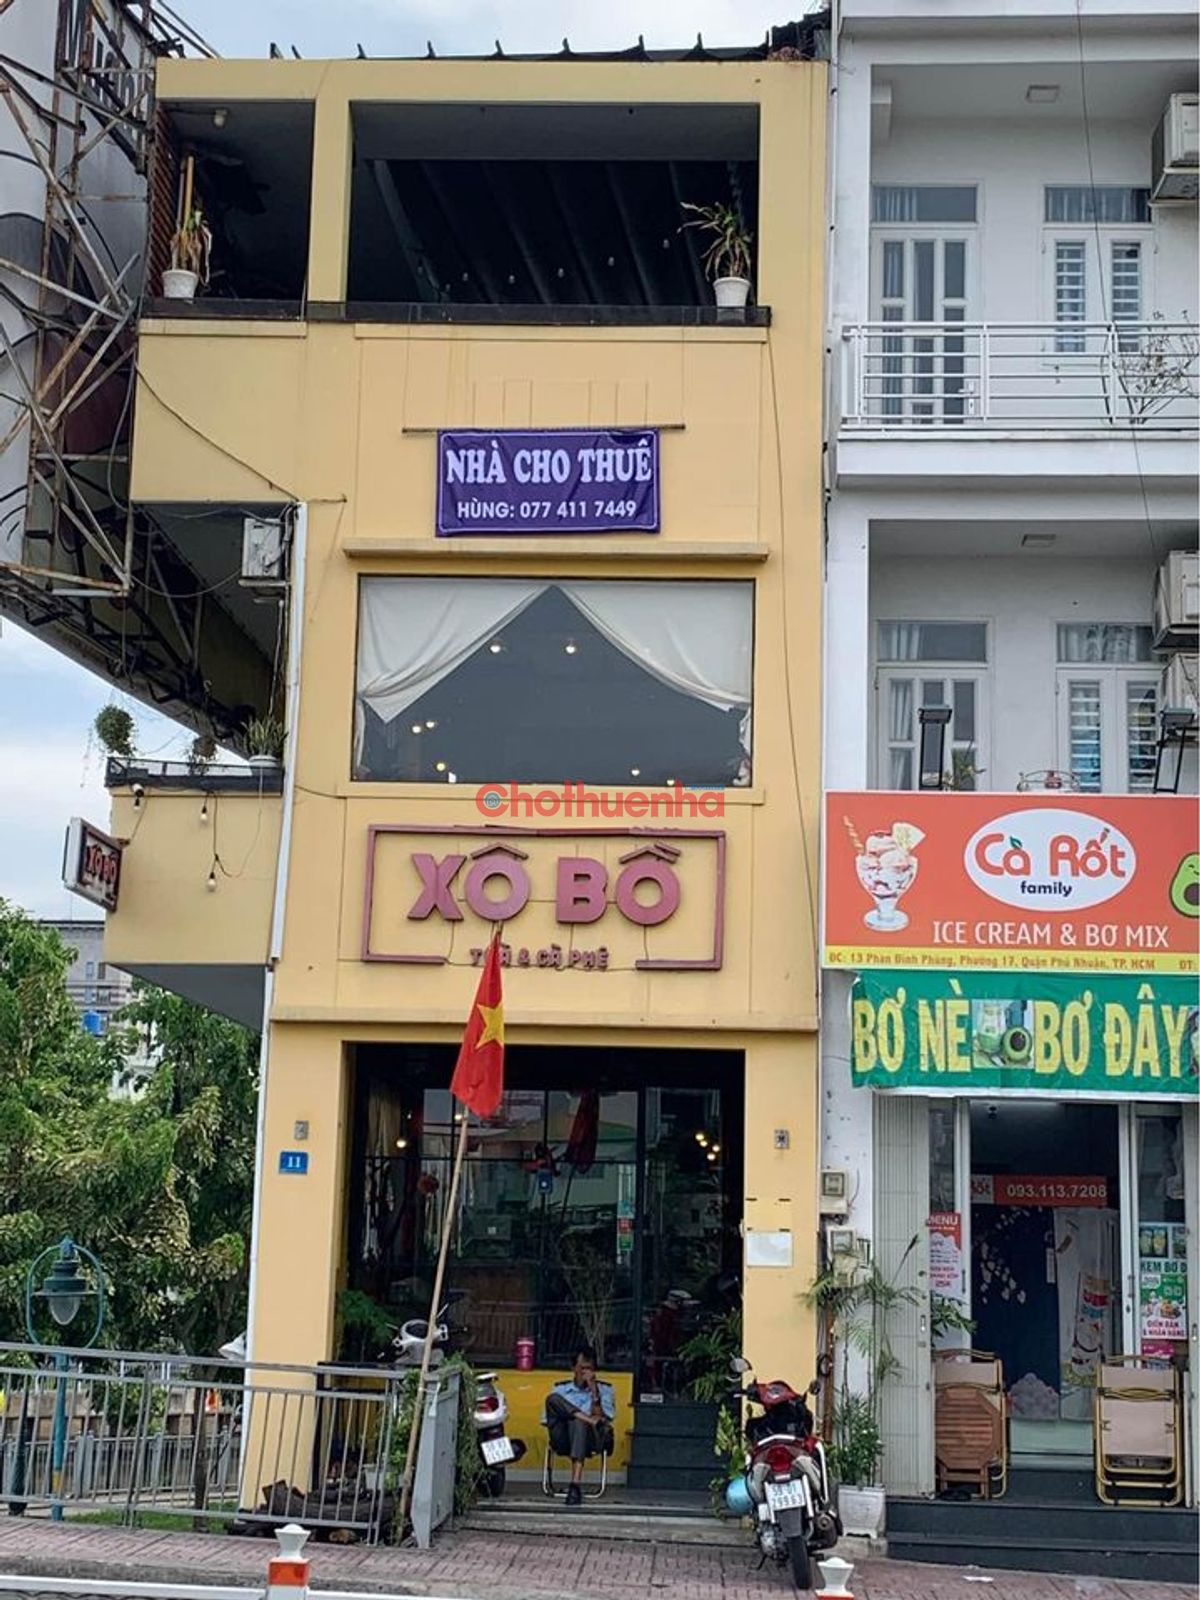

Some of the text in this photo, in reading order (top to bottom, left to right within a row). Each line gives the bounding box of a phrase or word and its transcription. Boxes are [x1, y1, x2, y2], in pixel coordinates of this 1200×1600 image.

[446, 438, 652, 484] NHÀ CHO THUÊ
[457, 497, 636, 518] HÙNG: 077 411 7449
[974, 827, 1126, 878] Cà Rốt
[407, 842, 531, 922] XÔ
[1020, 881, 1073, 898] family
[933, 921, 1169, 948] ICE CREAM & BƠ MIX
[469, 942, 609, 972] TÀ & CÀ PHÊ
[850, 951, 863, 964] 13
[867, 952, 891, 964] Phan
[1131, 958, 1156, 970] HCM
[853, 978, 1189, 1078] BƠ NÈ BƠ ĐÂY
[287, 1156, 301, 1169] 11
[1006, 1184, 1108, 1198] 093.113.7208
